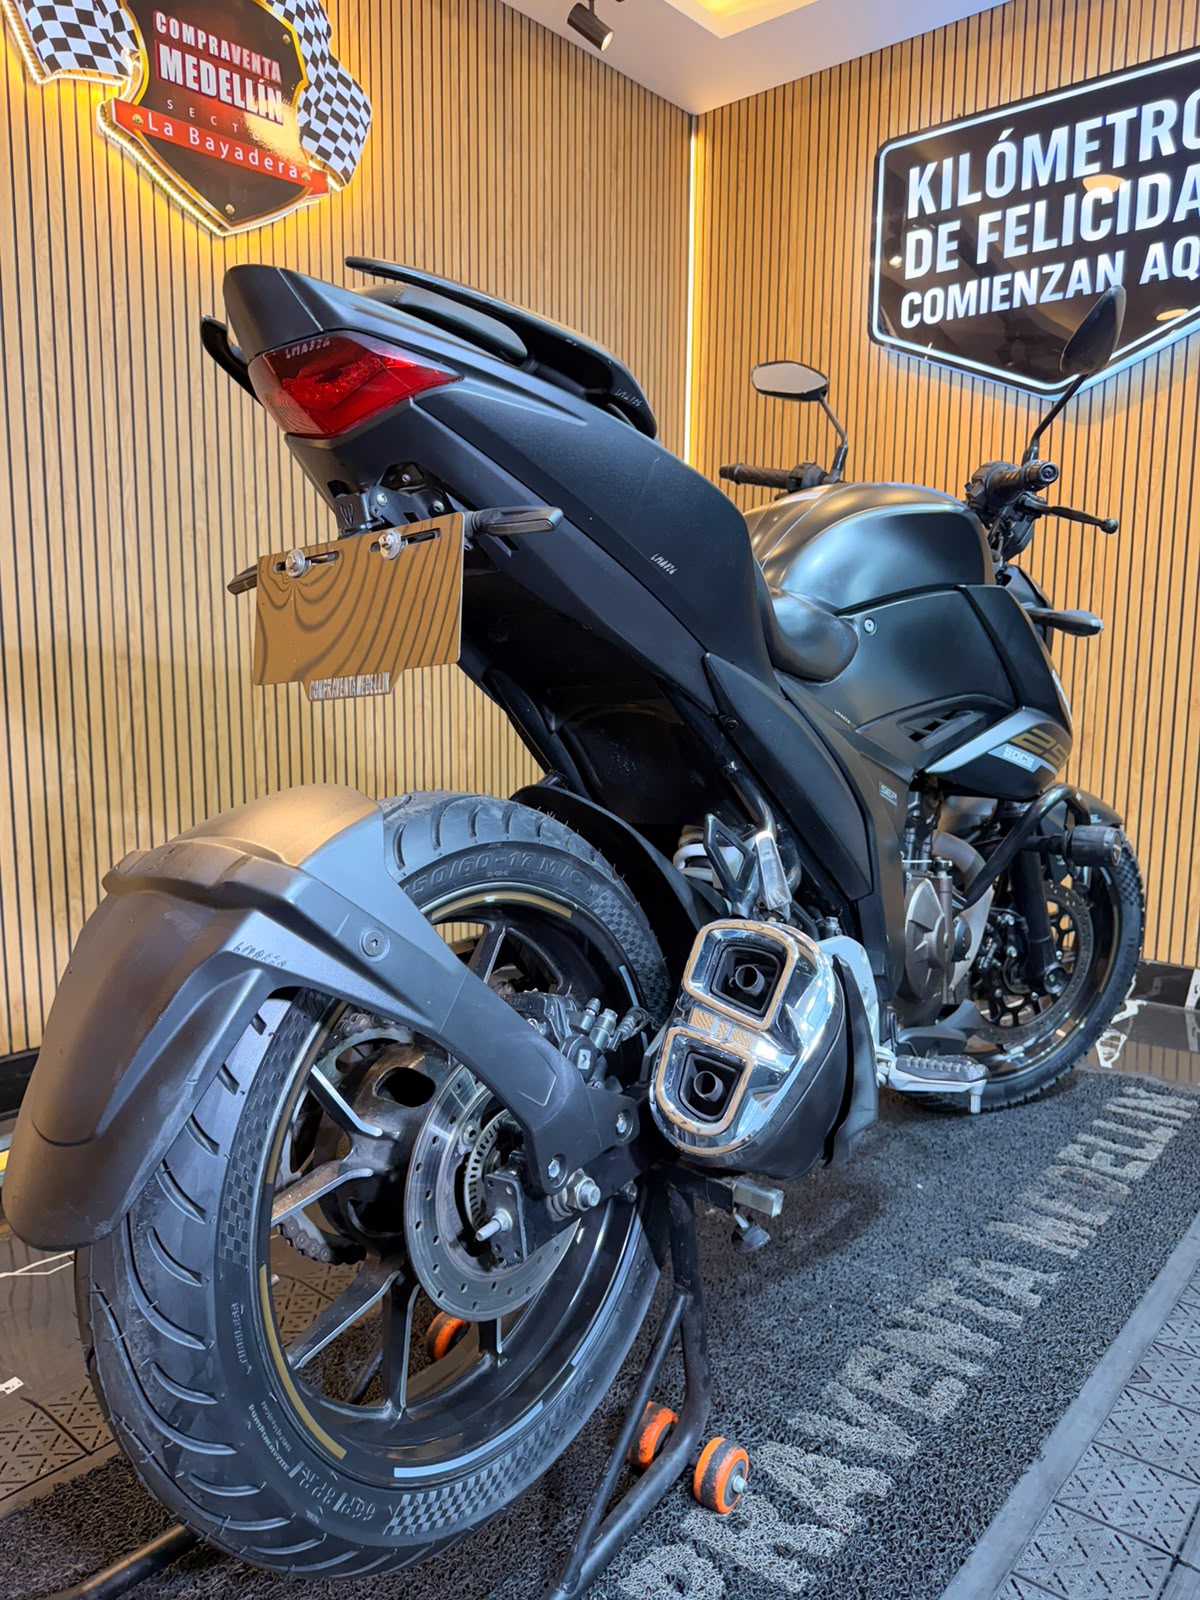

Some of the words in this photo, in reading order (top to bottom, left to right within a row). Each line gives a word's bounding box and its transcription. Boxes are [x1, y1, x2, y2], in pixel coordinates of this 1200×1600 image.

[155, 11, 282, 84] COMPRAVENTA
[158, 43, 284, 124] MEDELLÍN
[148, 112, 174, 138] La
[189, 126, 299, 179] Bayadera
[904, 222, 961, 281] DE
[900, 250, 1125, 329] COMIENZAN
[1003, 746, 1035, 769] SOCS
[984, 1085, 1199, 1260] MEDELLIN
